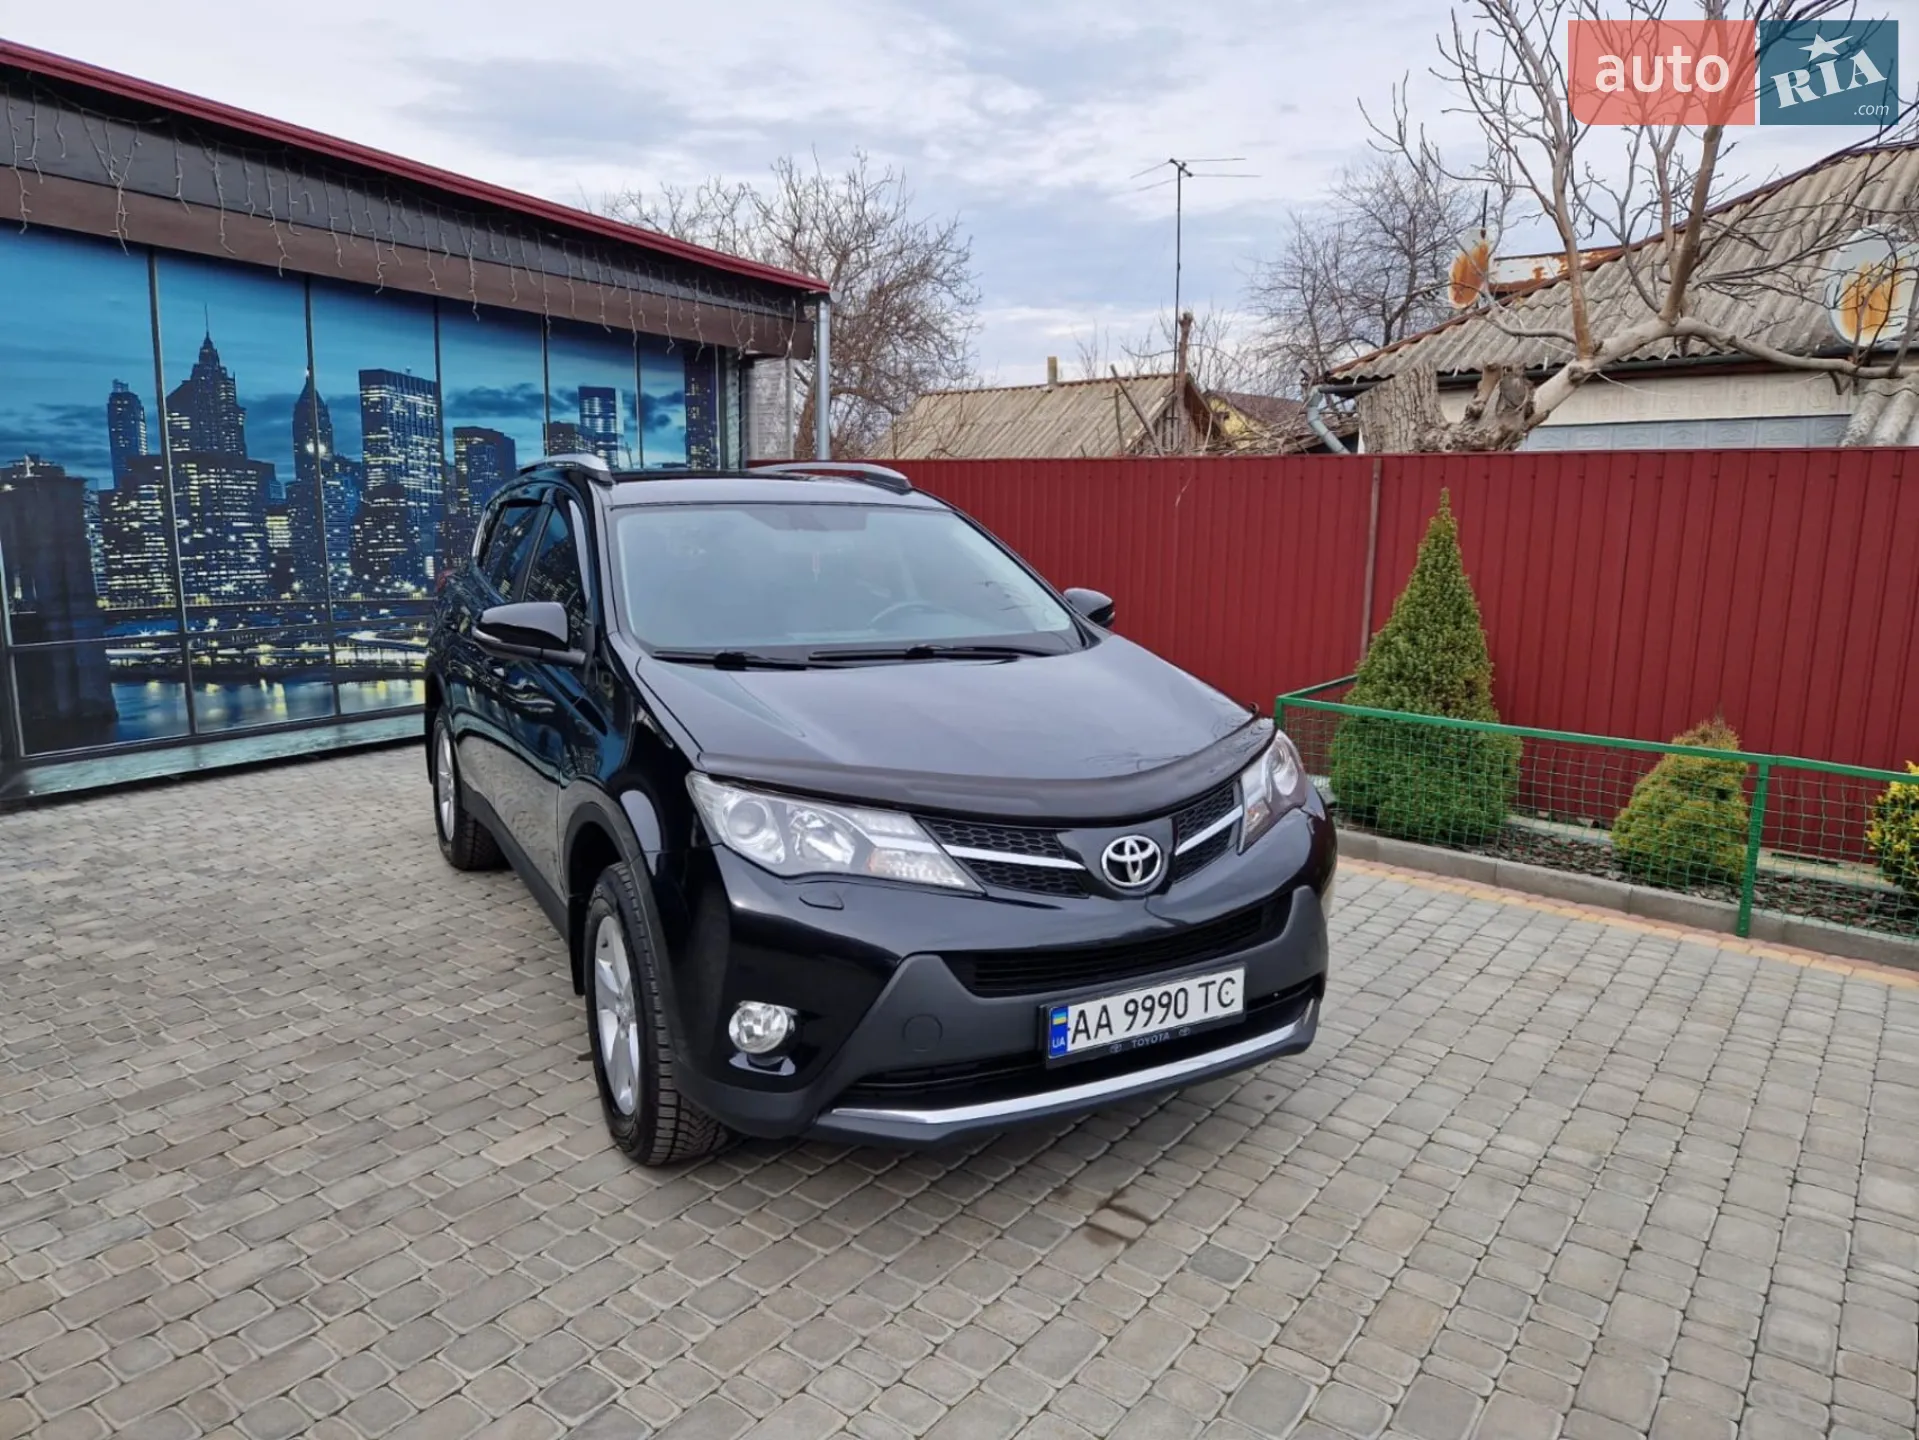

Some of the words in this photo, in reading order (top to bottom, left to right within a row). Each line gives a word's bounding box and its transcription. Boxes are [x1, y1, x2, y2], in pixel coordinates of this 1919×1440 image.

[1071, 1004, 1113, 1044] AA
[1123, 987, 1189, 1032] 9990
[1198, 976, 1236, 1013] TC
[1052, 1036, 1066, 1049] UA
[1132, 1032, 1171, 1048] TOYOTA
